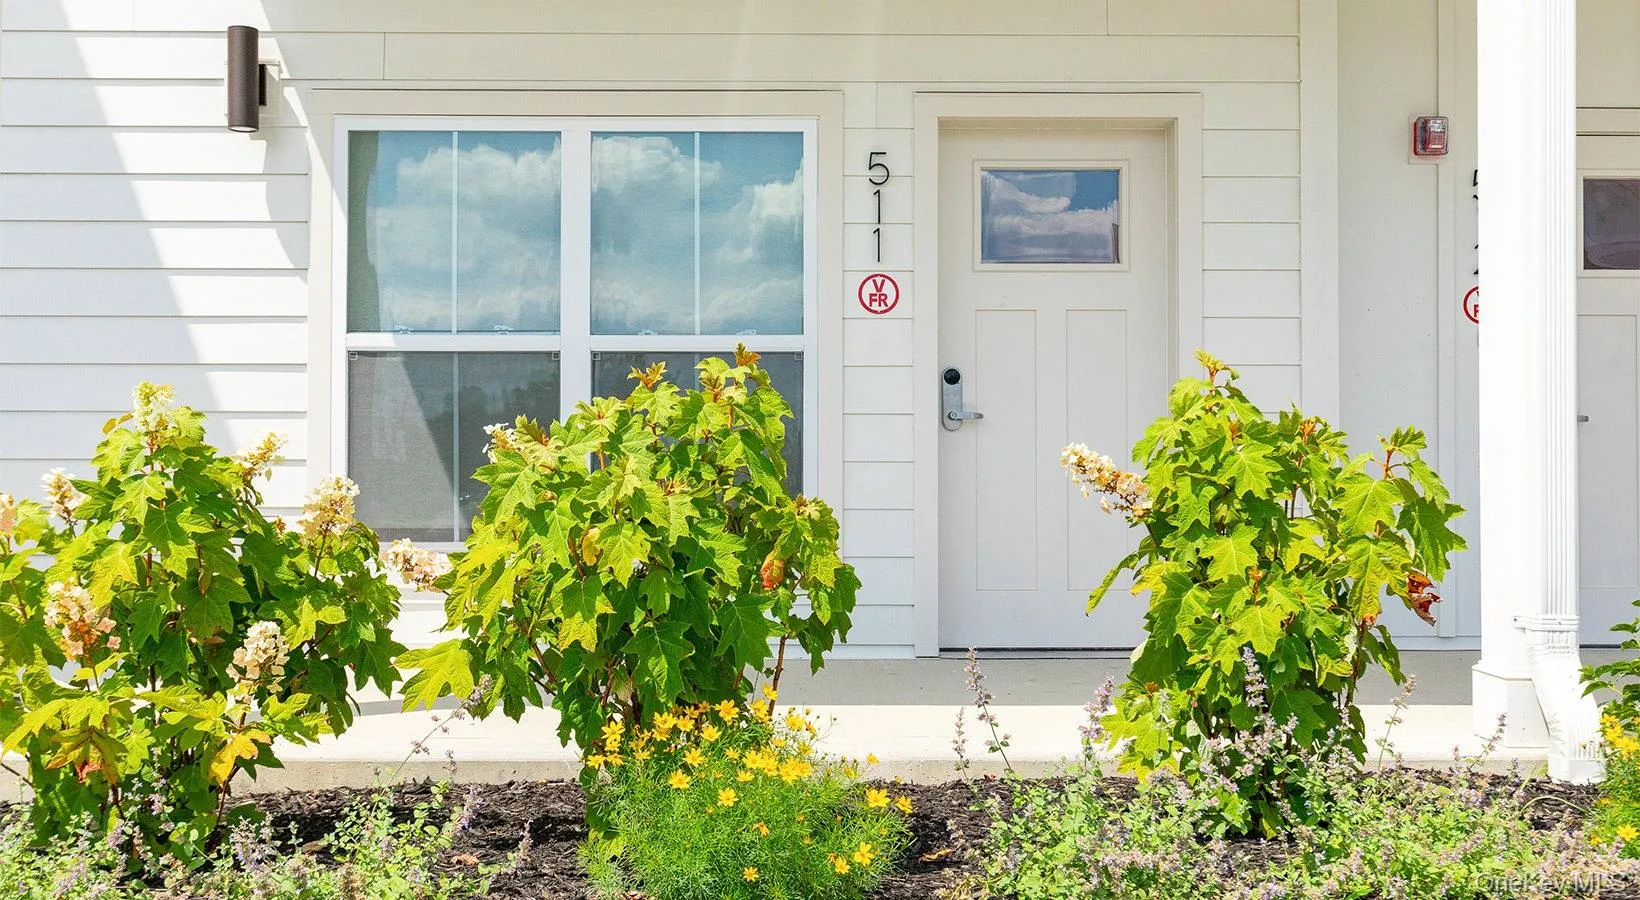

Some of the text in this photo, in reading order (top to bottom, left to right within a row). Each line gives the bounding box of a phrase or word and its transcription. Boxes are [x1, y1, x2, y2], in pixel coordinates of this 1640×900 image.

[868, 151, 890, 262] 511
[872, 279, 886, 293] V
[868, 293, 888, 308] FR
